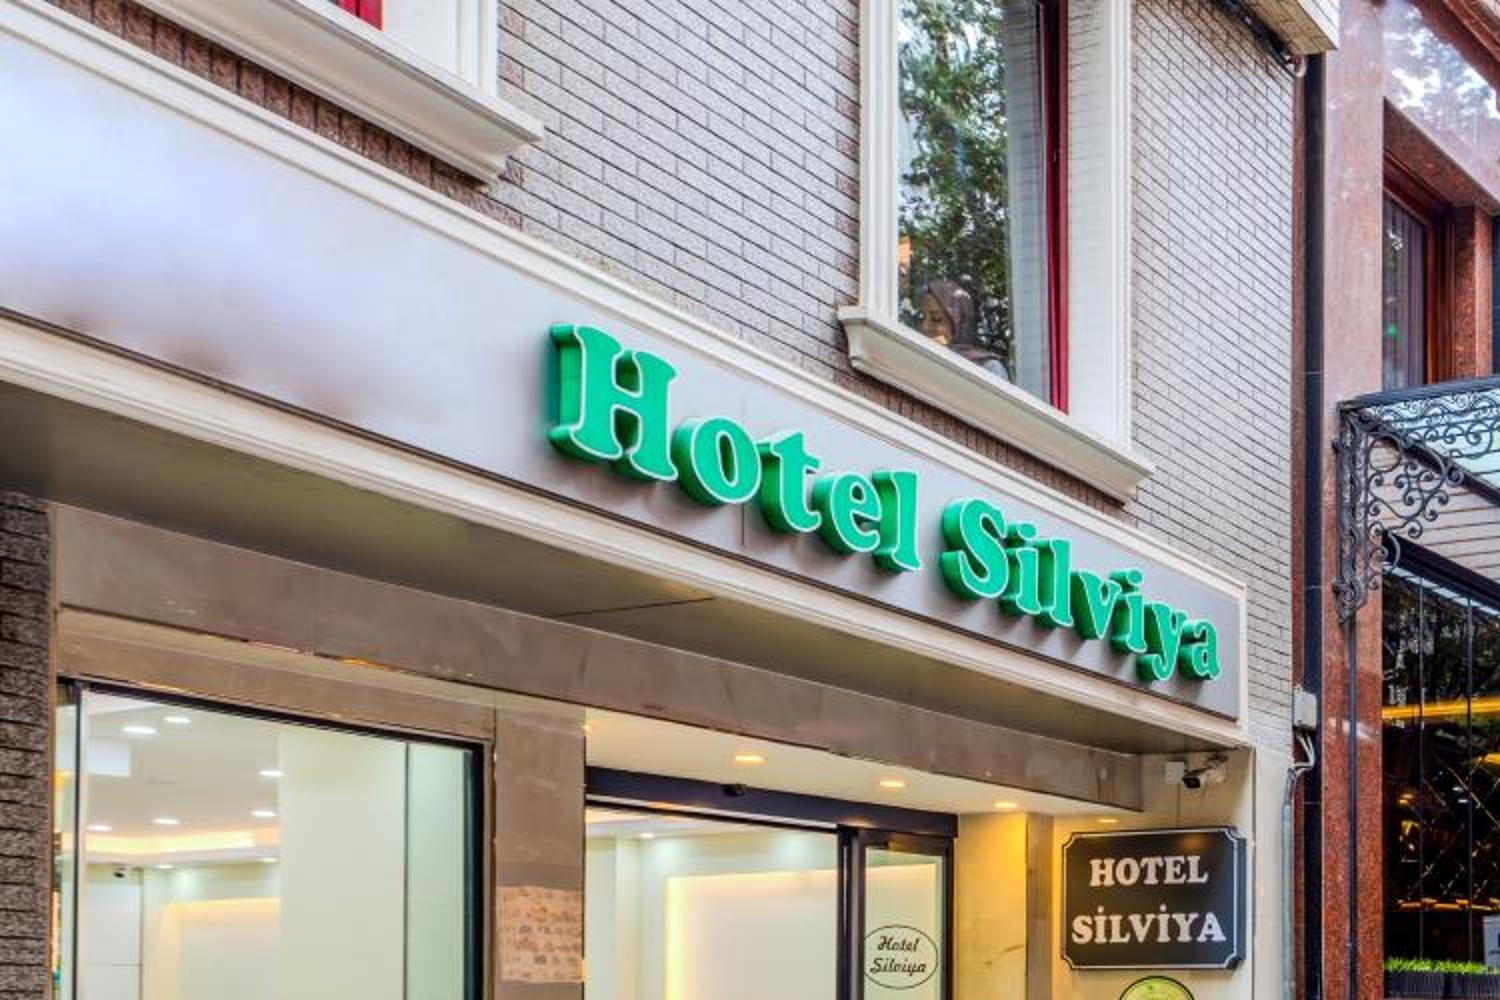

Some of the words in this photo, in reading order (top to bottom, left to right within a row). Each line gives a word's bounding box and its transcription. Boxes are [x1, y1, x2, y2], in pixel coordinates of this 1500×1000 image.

[549, 324, 921, 573] Hotel
[941, 499, 1221, 682] Silviya
[1089, 855, 1209, 887] HOTEL
[1071, 903, 1227, 945] SİLVİYA
[877, 935, 919, 952] Hotel
[870, 957, 926, 976] Silviya
